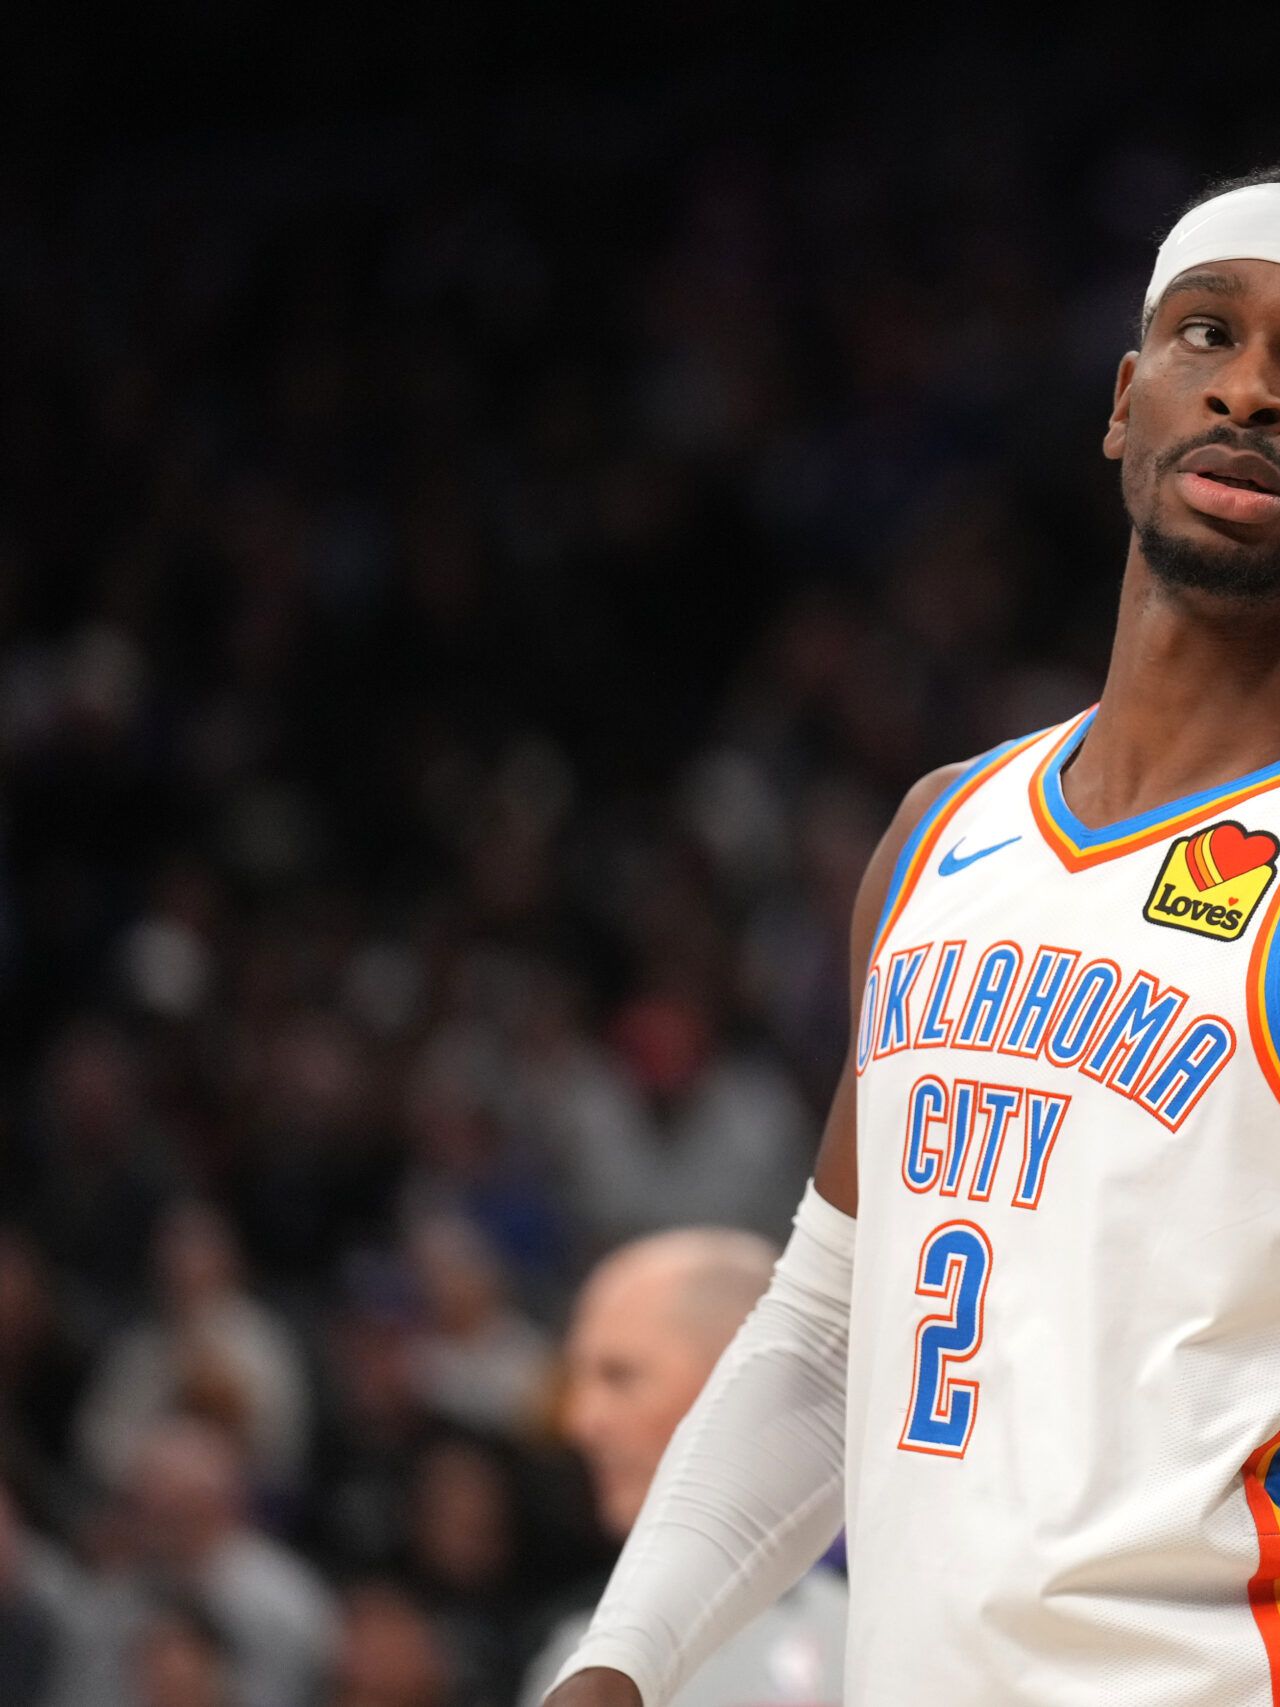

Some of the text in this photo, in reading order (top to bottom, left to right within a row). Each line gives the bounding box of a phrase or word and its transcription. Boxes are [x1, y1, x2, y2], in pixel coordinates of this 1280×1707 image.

[856, 940, 1237, 1133] OKLAHOMA
[901, 1074, 1072, 1210] CITY
[897, 1218, 993, 1460] 2
